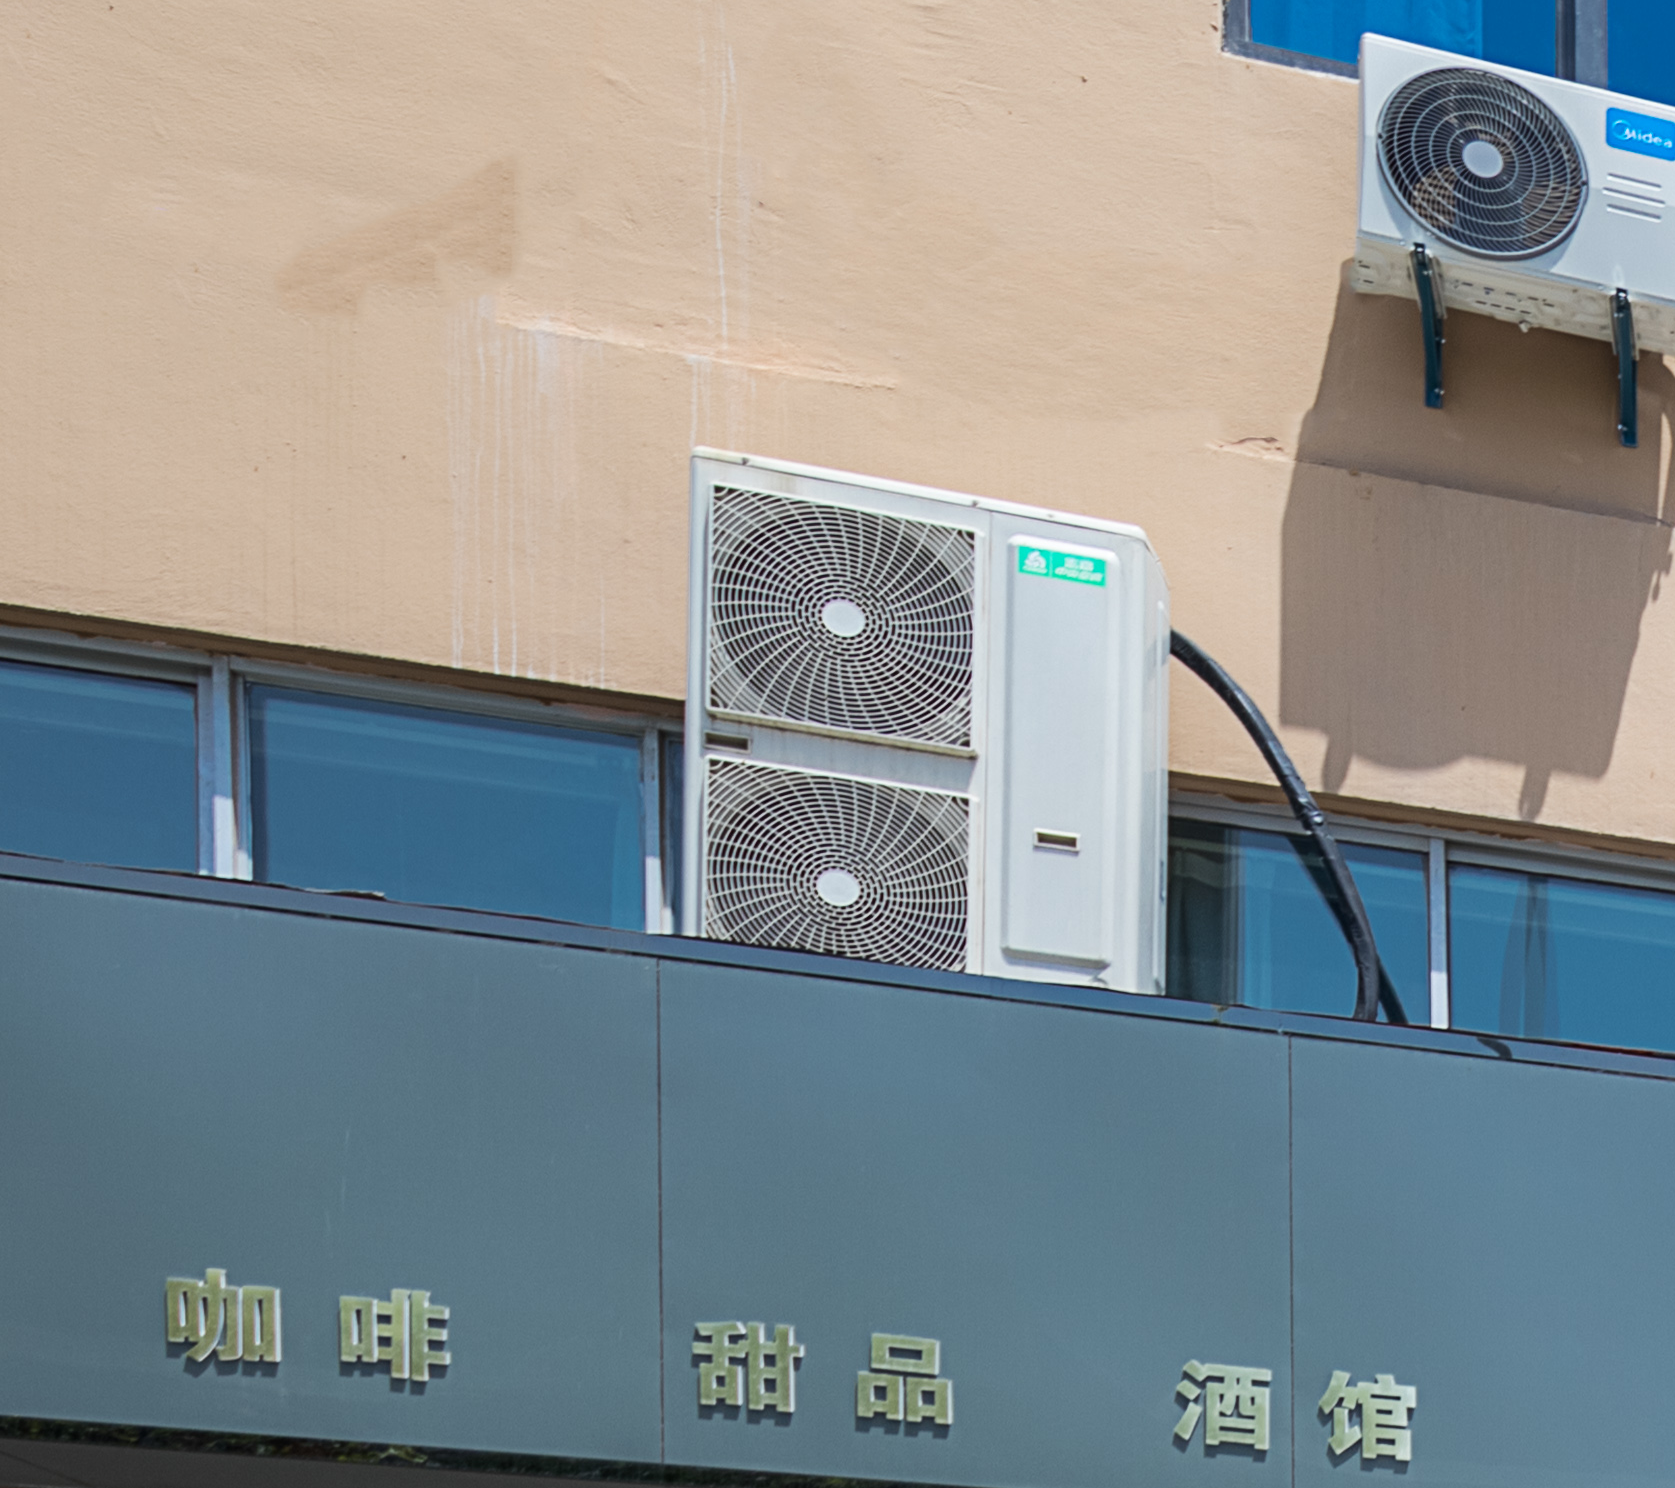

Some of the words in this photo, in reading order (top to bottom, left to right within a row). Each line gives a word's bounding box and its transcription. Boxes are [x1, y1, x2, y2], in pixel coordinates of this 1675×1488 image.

[1610, 119, 1675, 151] Midea
[164, 1267, 453, 1383] 咖啡
[692, 1320, 956, 1427] 甜品
[1171, 1357, 1420, 1465] 酒馆
